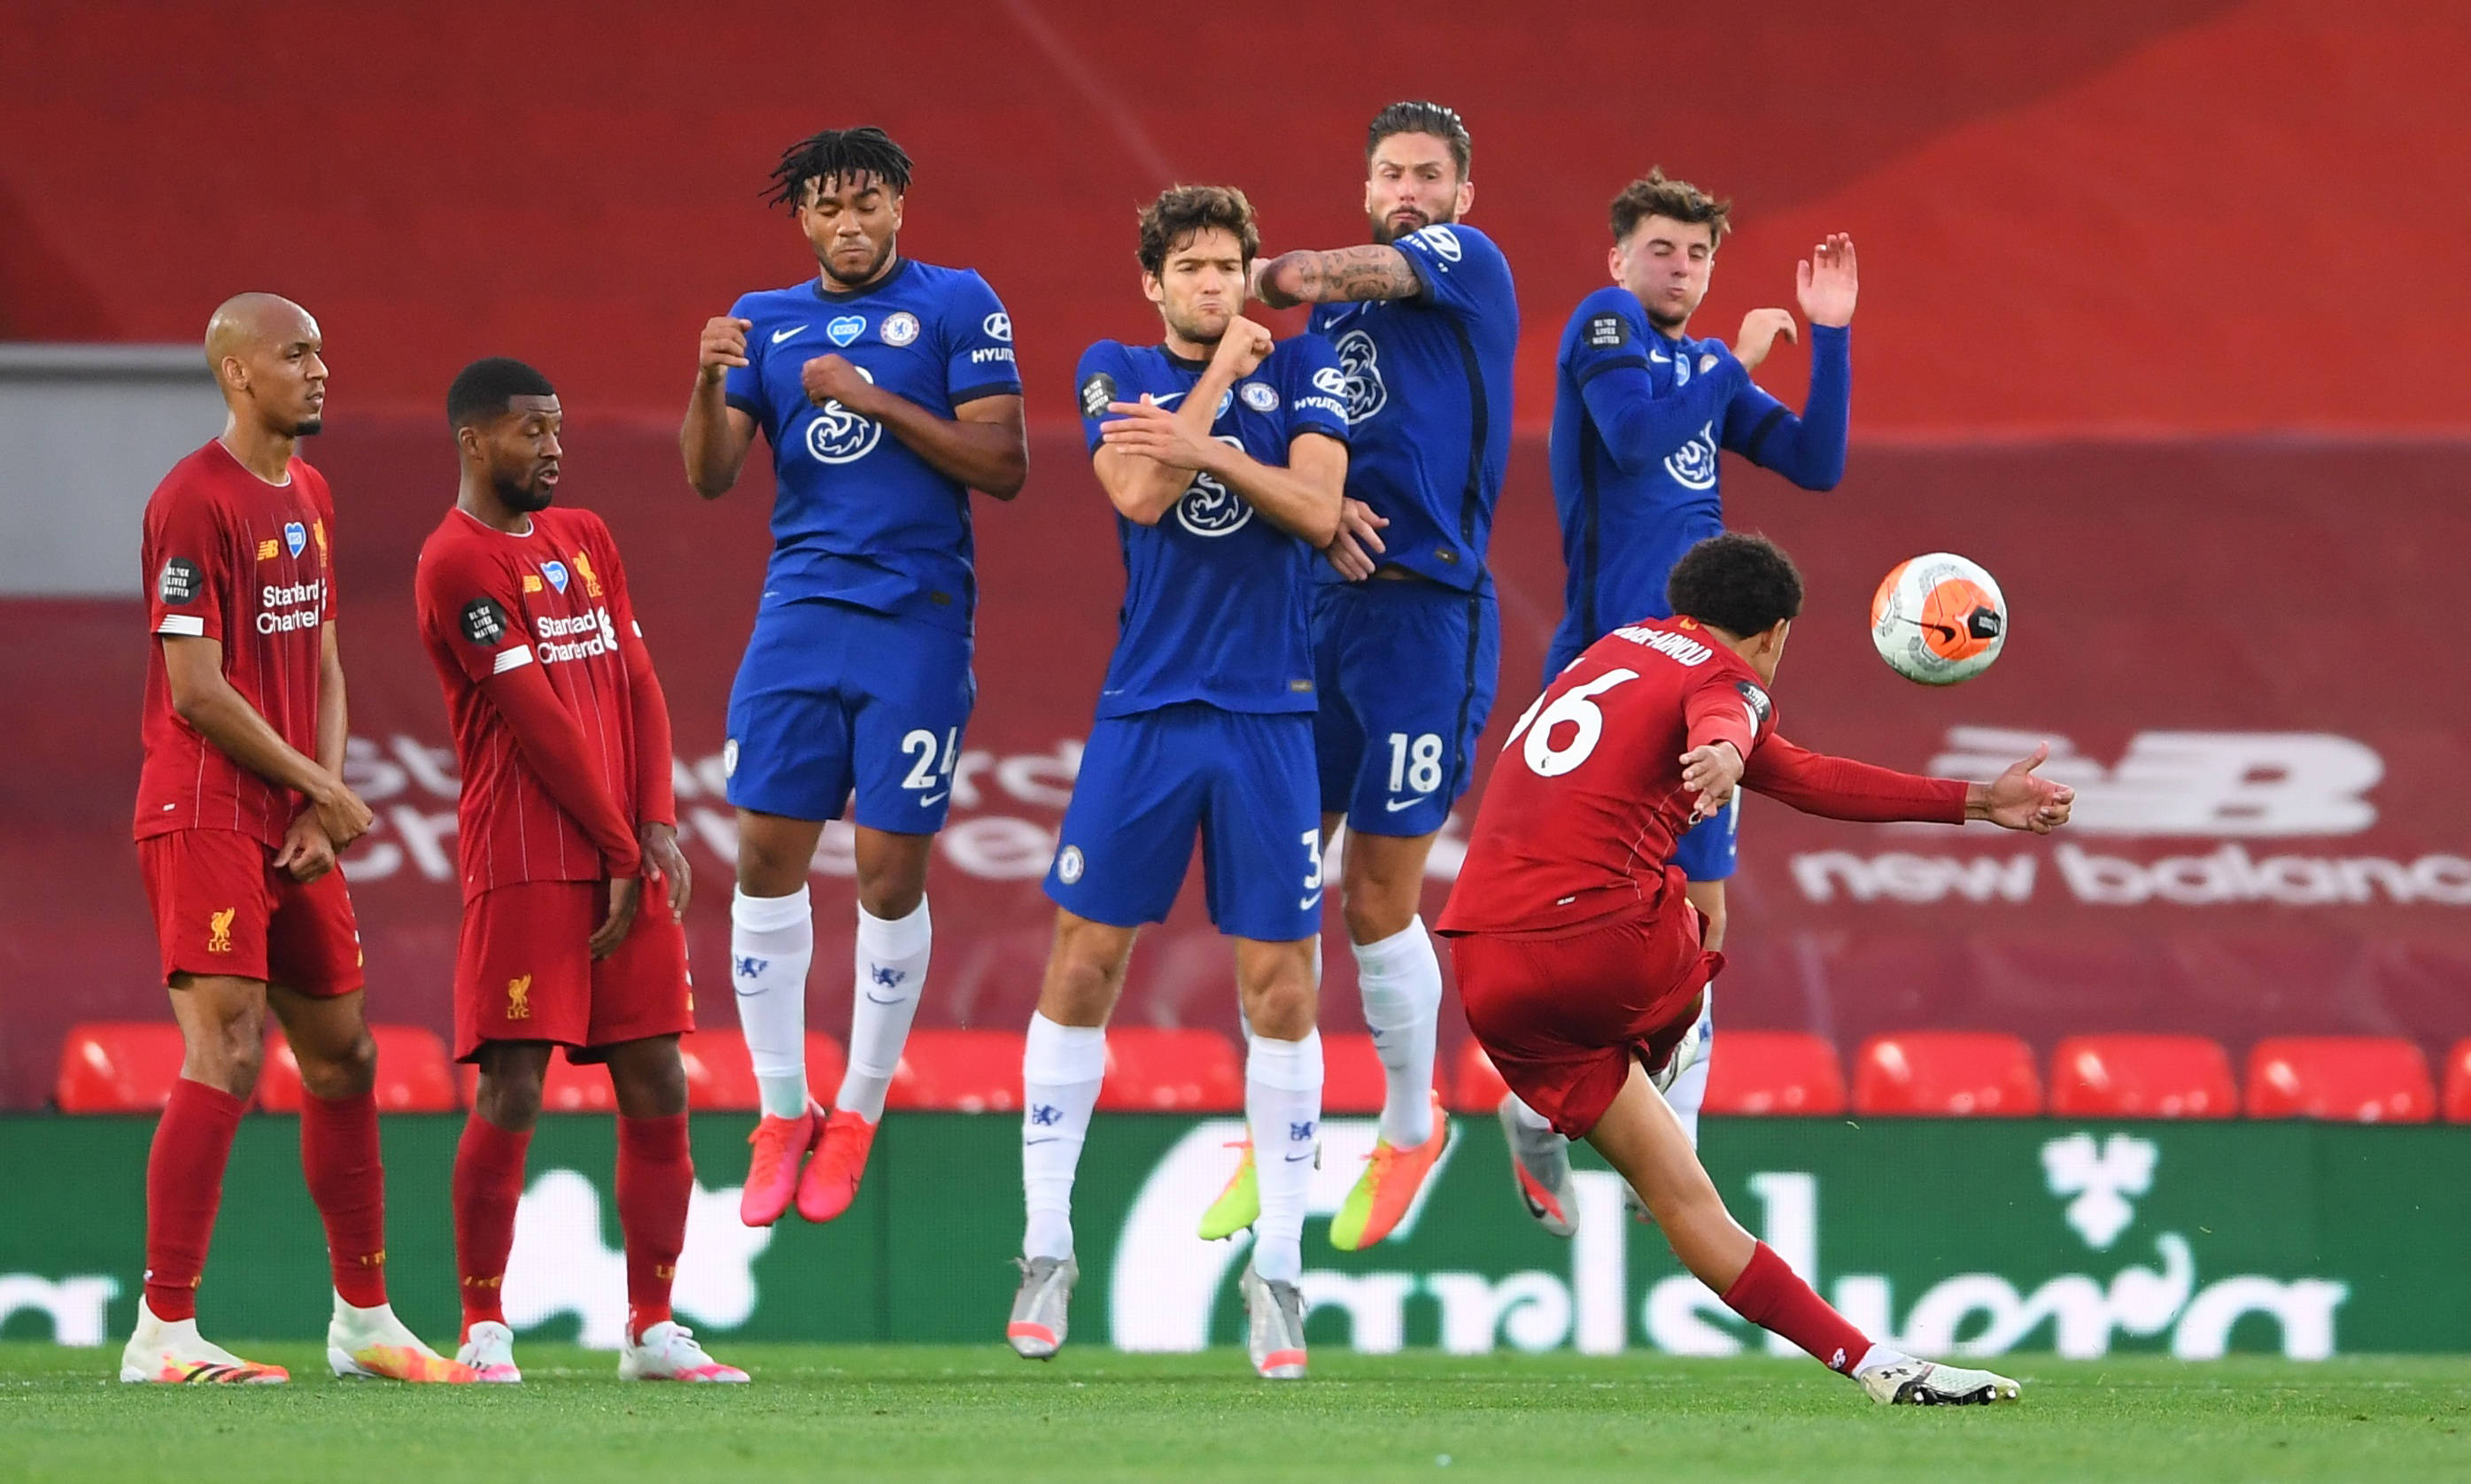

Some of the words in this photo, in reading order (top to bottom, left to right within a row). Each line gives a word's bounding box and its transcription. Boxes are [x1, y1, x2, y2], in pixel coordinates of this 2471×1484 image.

[972, 347, 1015, 364] HYUN
[1387, 732, 1443, 792] 18
[1301, 828, 1322, 890] 3
[1789, 849, 2038, 904] new
